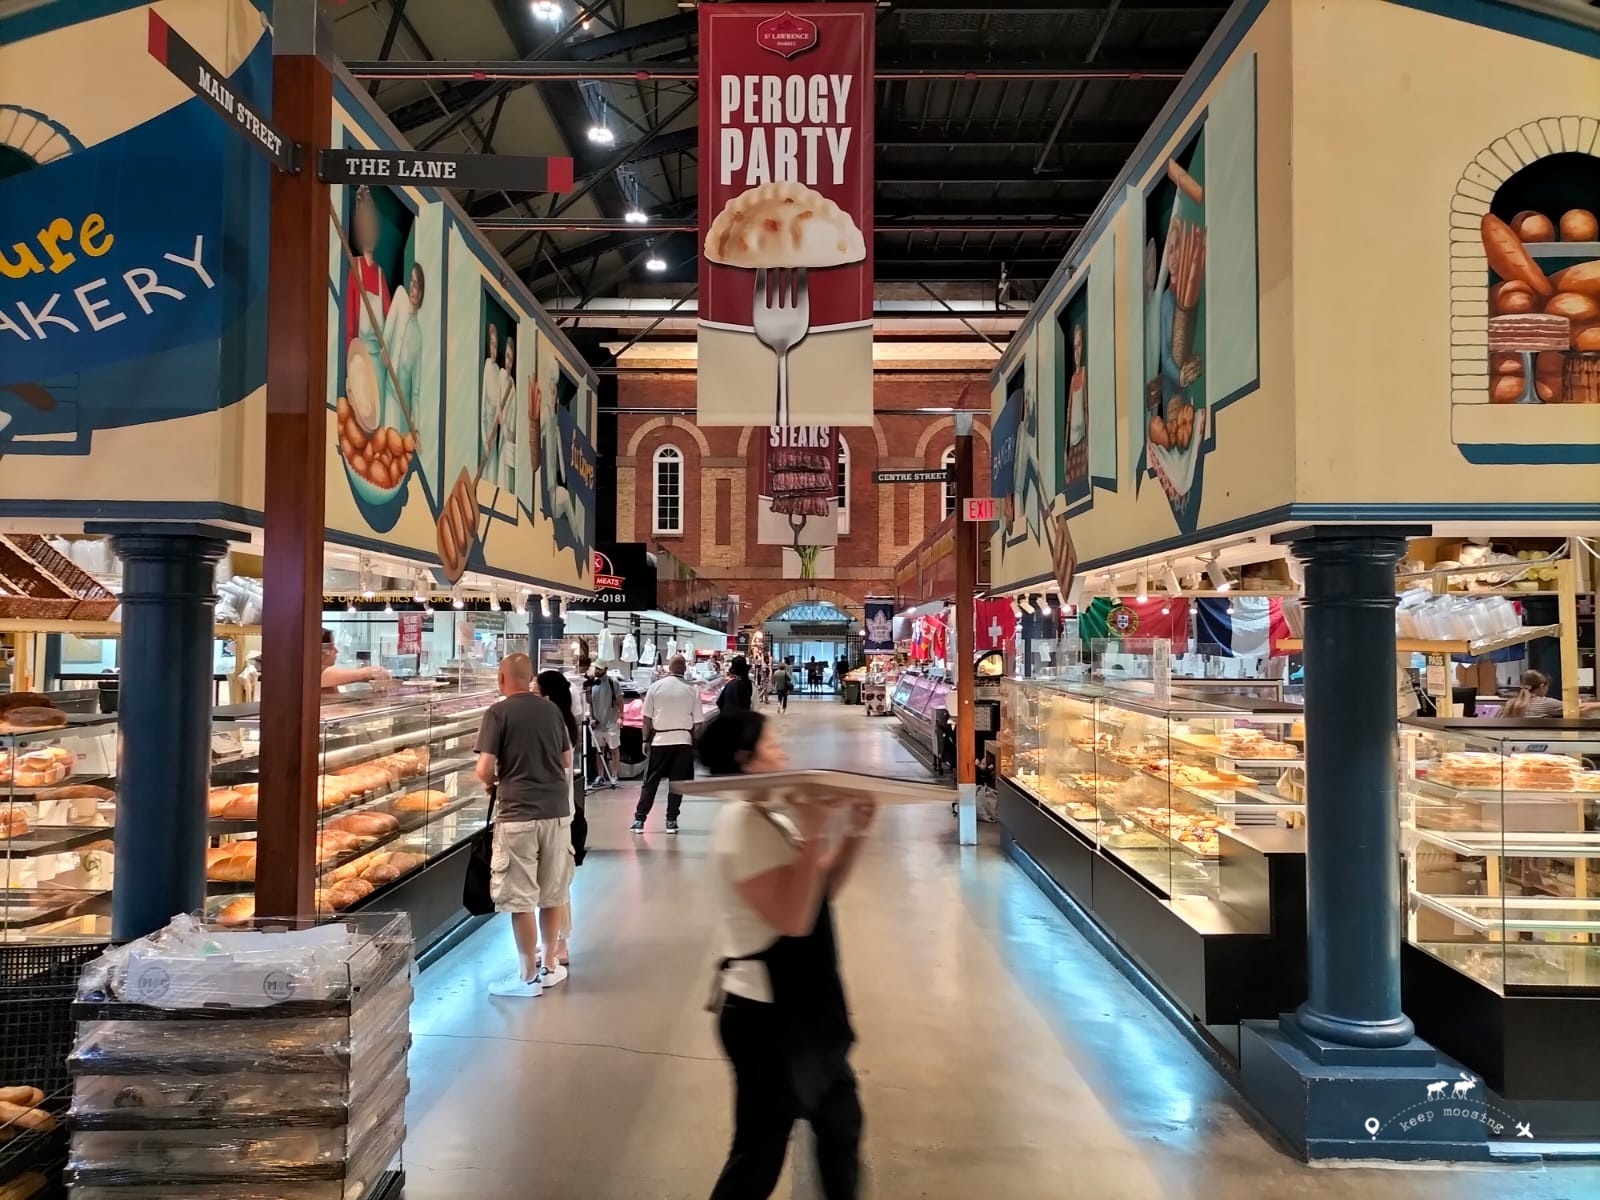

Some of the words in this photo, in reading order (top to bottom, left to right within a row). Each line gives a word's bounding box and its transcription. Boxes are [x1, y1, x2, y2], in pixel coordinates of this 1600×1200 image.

[720, 74, 853, 124] PEROGY
[198, 65, 235, 114] MAIN
[236, 102, 282, 156] STREET
[720, 126, 852, 185] PARTY
[345, 158, 391, 176] THE
[397, 159, 457, 179] LANE
[769, 425, 830, 448] STEAKS
[878, 473, 912, 481] CENTRE
[913, 472, 948, 480] STREET
[969, 500, 995, 519] EXIT
[596, 577, 619, 586] MEATS
[1428, 656, 1444, 666] PASS
